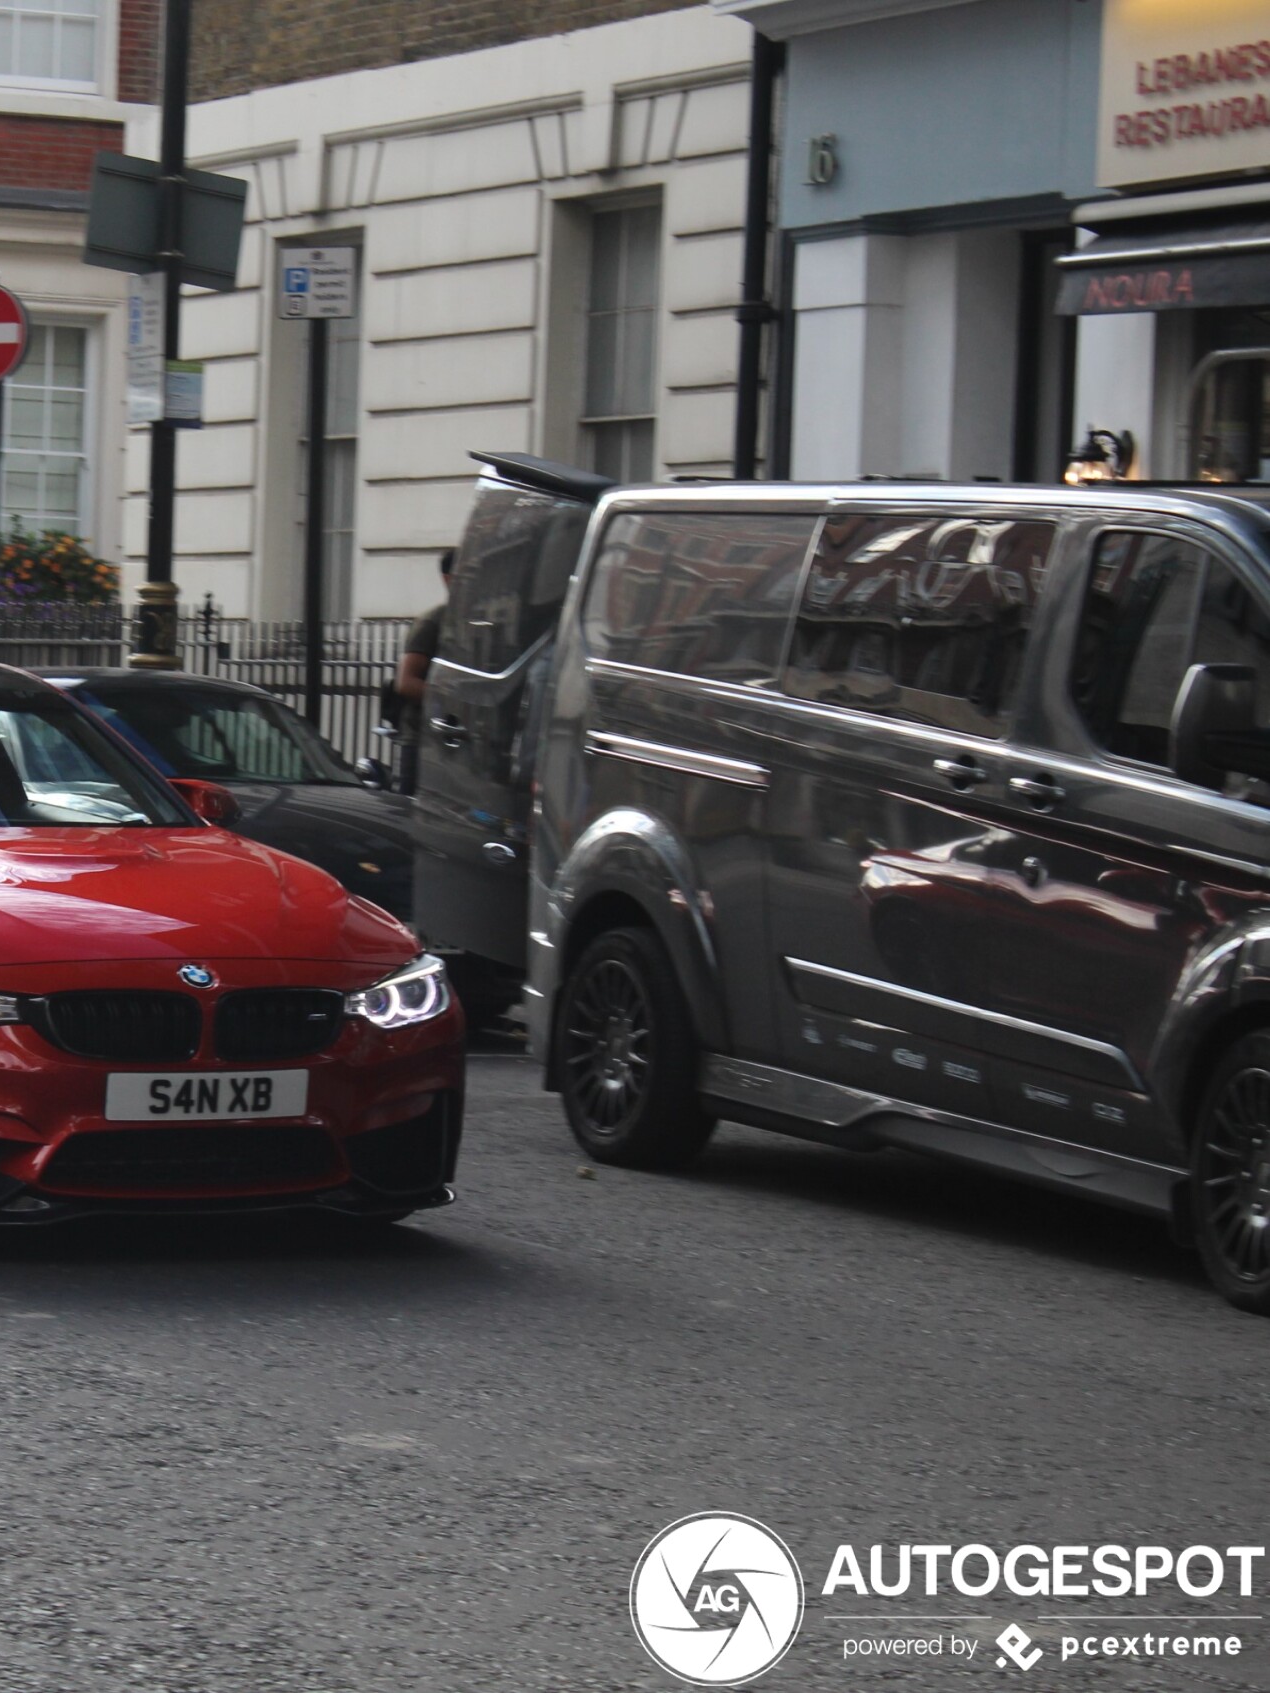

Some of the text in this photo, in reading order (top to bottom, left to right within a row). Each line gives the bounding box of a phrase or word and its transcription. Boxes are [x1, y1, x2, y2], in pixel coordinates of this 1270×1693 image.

[802, 132, 838, 188] 16
[1082, 269, 1194, 309] NOURA
[148, 1077, 273, 1114] S4N XB
